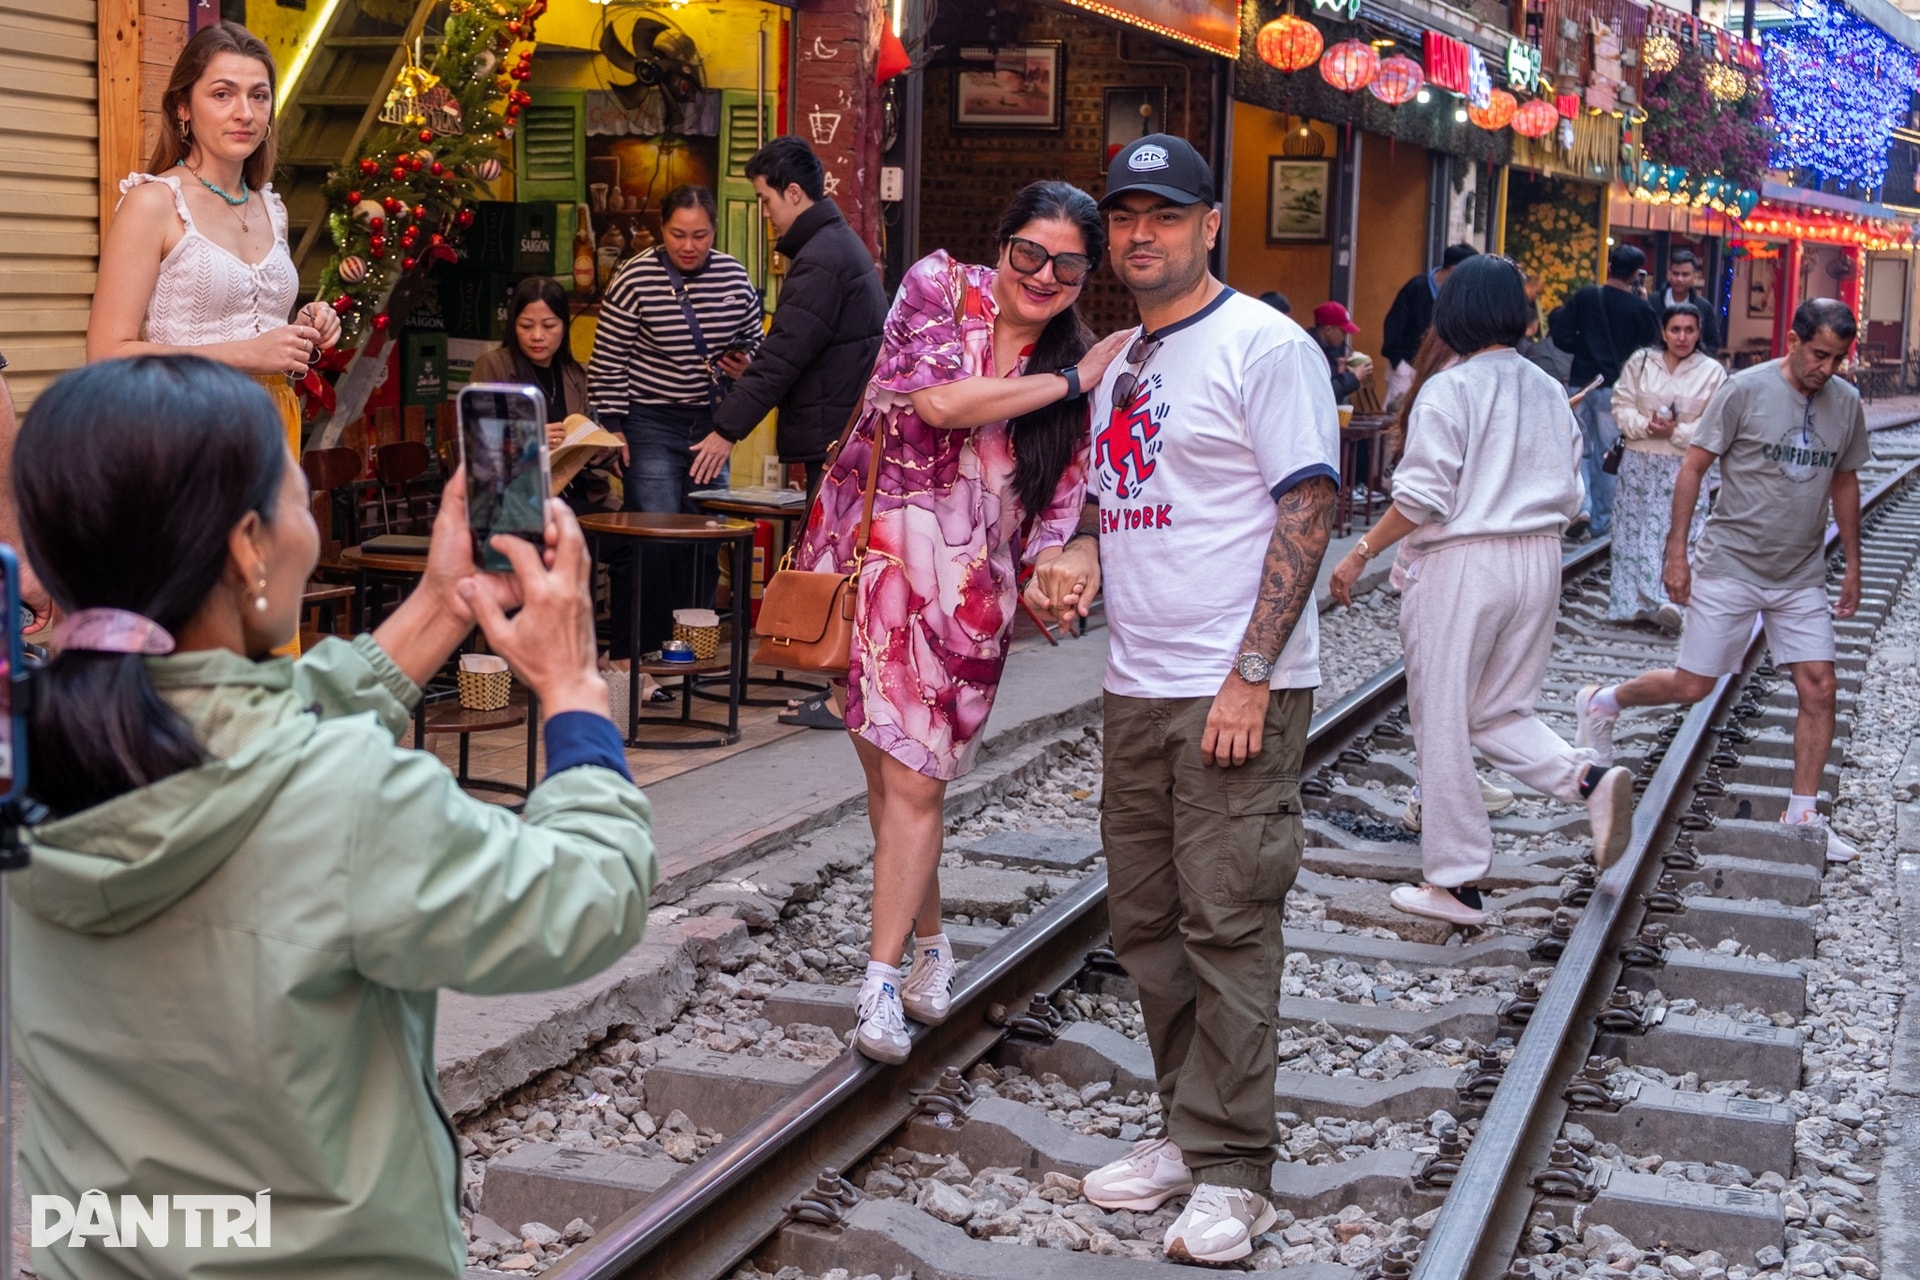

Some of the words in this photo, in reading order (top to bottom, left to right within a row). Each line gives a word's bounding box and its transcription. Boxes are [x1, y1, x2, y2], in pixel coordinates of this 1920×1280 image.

[521, 239, 550, 252] SAIGON
[1100, 508, 1120, 534] EW
[1123, 504, 1172, 530] YORK
